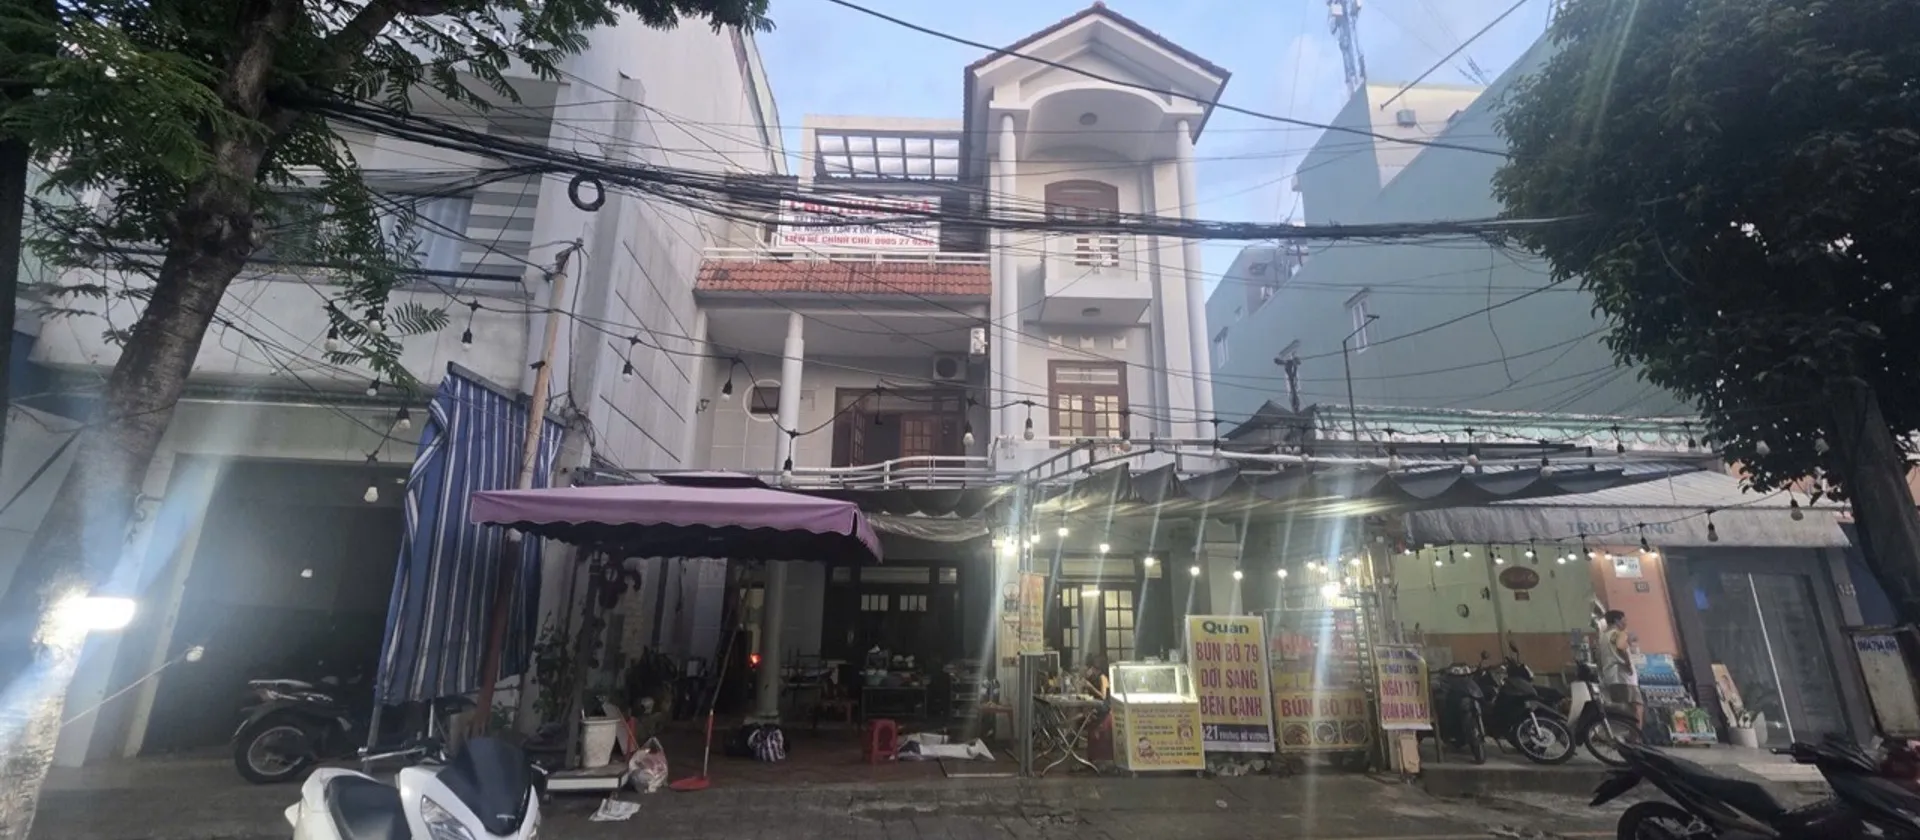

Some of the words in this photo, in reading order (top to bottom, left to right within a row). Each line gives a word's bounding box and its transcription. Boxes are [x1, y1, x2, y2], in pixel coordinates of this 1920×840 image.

[1202, 620, 1249, 635] Quán
[1196, 638, 1221, 662] BÚN
[1225, 638, 1240, 663] BÒ
[1244, 643, 1259, 663] 79
[1226, 668, 1259, 690] SANG
[1281, 695, 1314, 717] BÚN
[1346, 697, 1363, 716] 79
